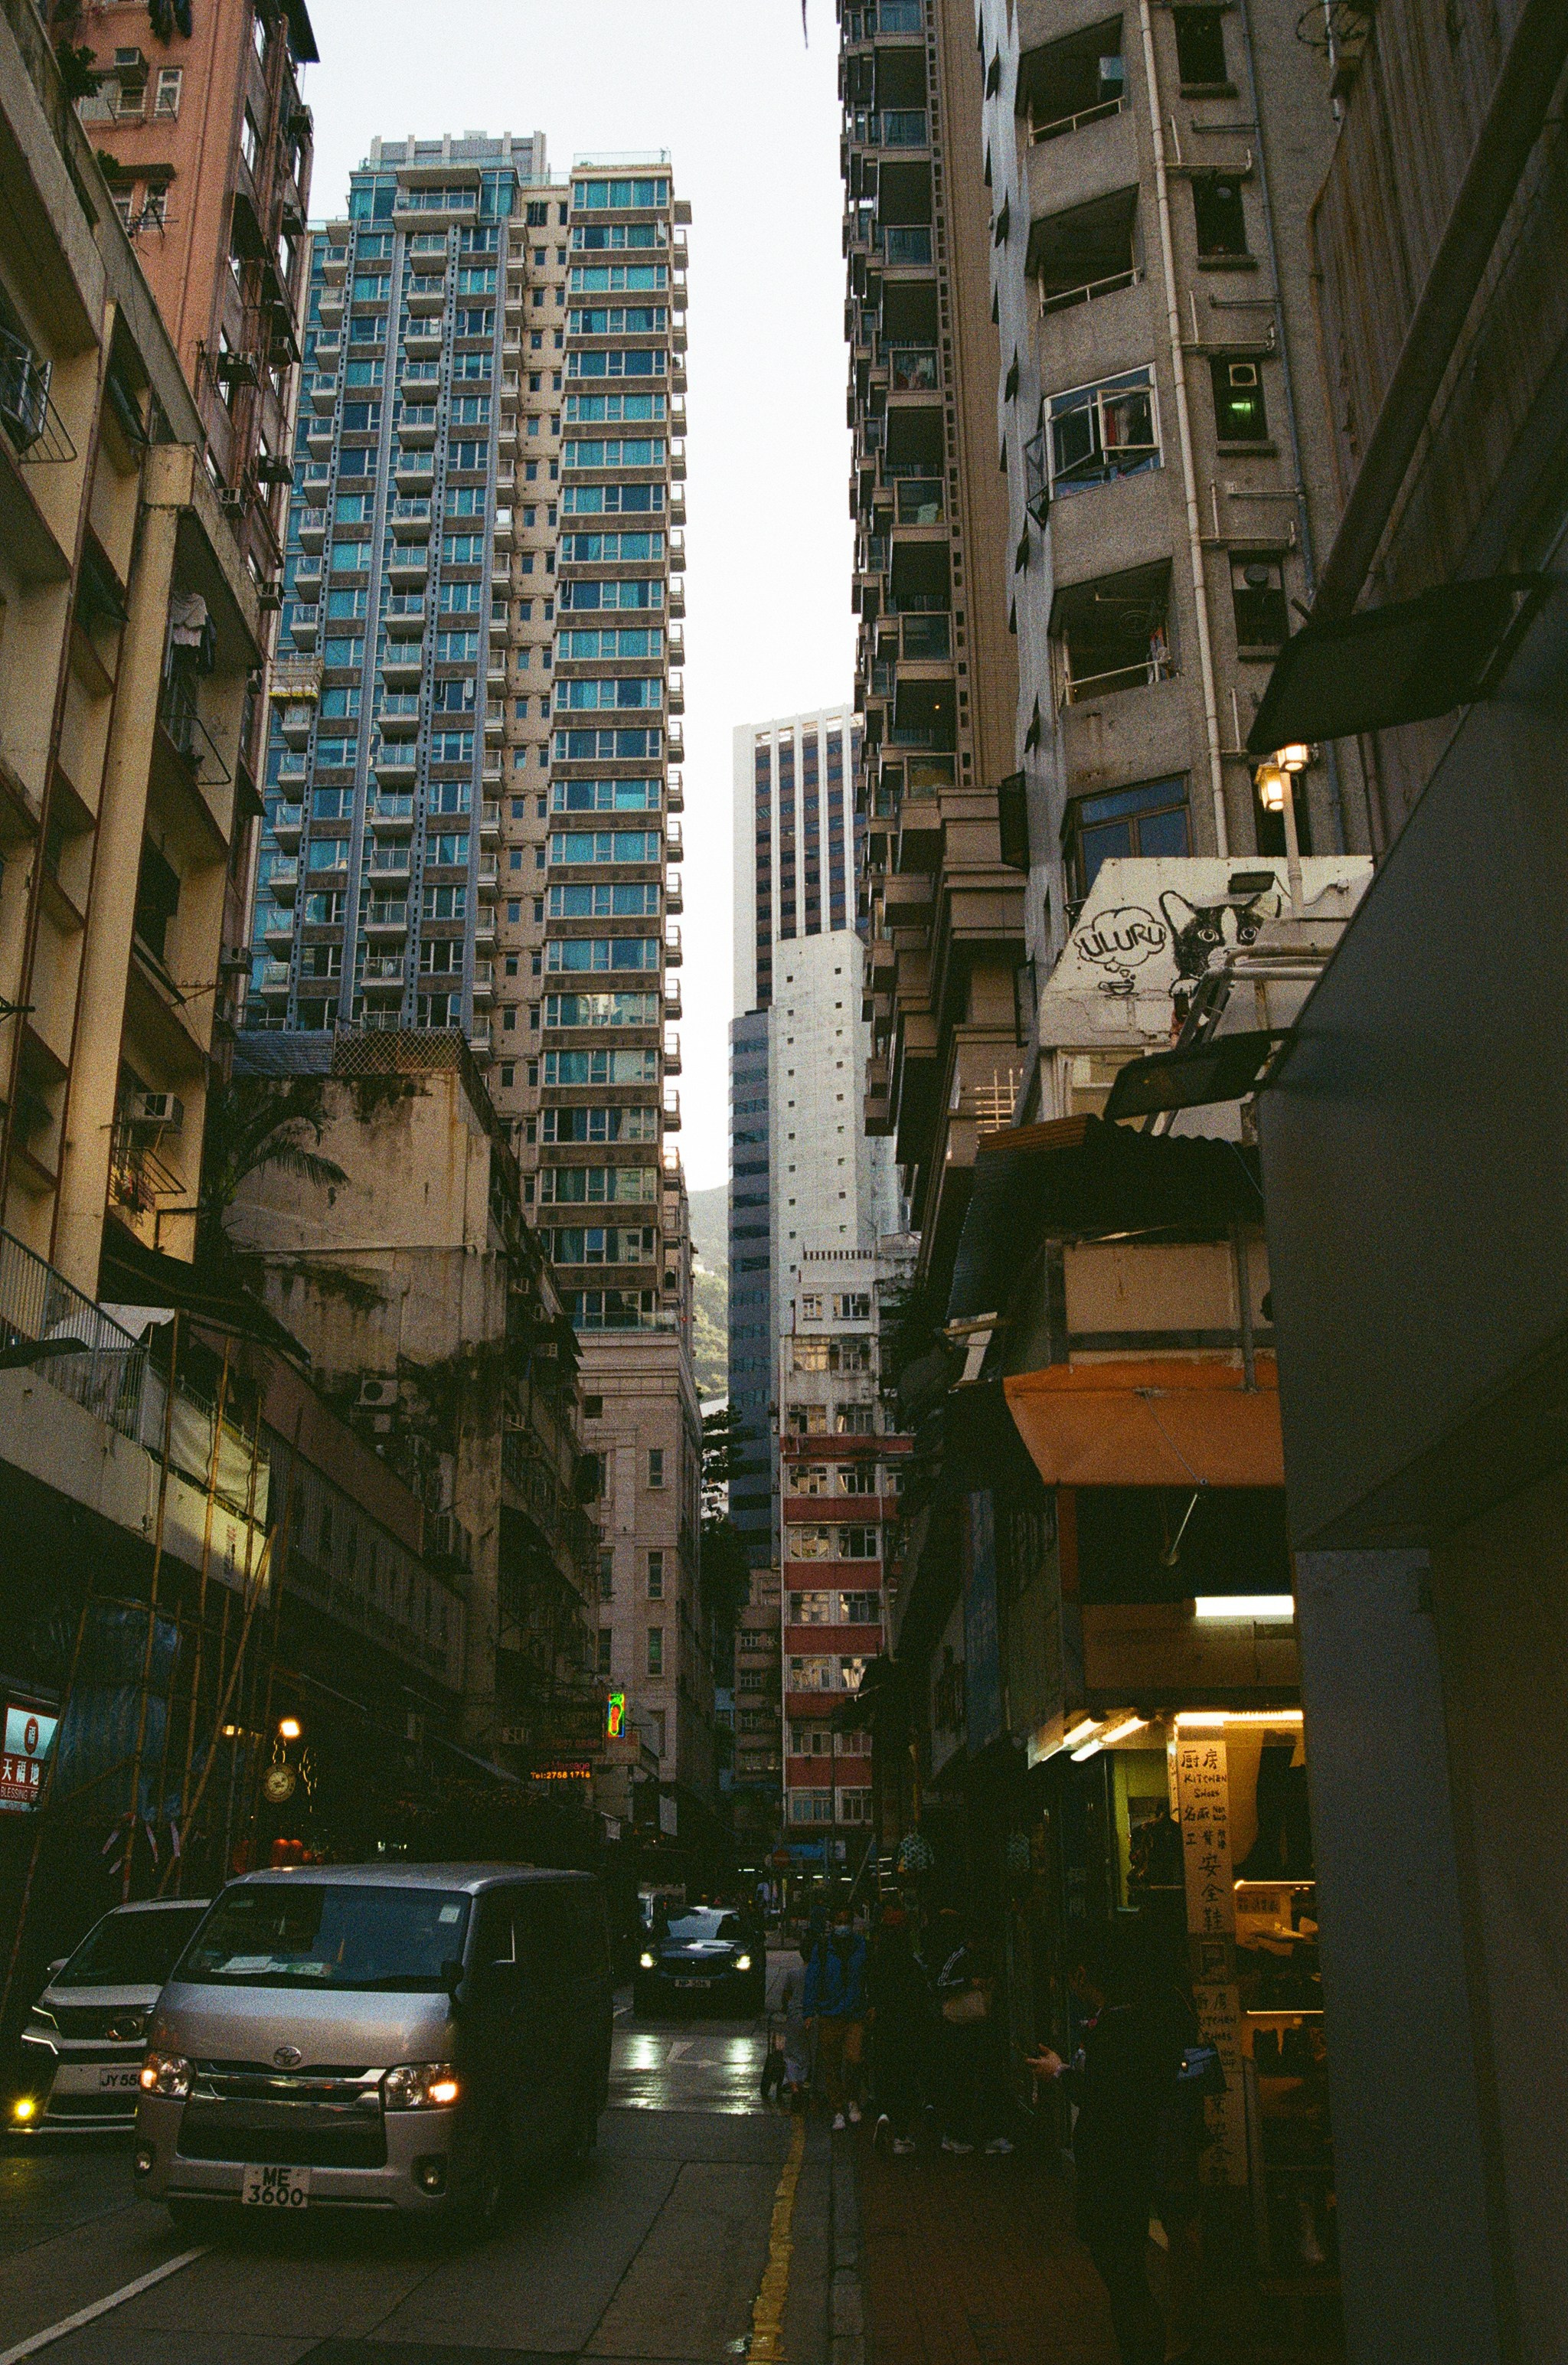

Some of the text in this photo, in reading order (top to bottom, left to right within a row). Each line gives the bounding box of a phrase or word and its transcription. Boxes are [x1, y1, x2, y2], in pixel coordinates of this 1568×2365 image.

[1080, 923, 1163, 957] ULURU
[2, 1758, 40, 1786] 天福地
[0, 1786, 28, 1801] BLESSING
[101, 2074, 141, 2086] JY 55
[263, 2167, 292, 2187] ME
[247, 2184, 303, 2207] 3600
